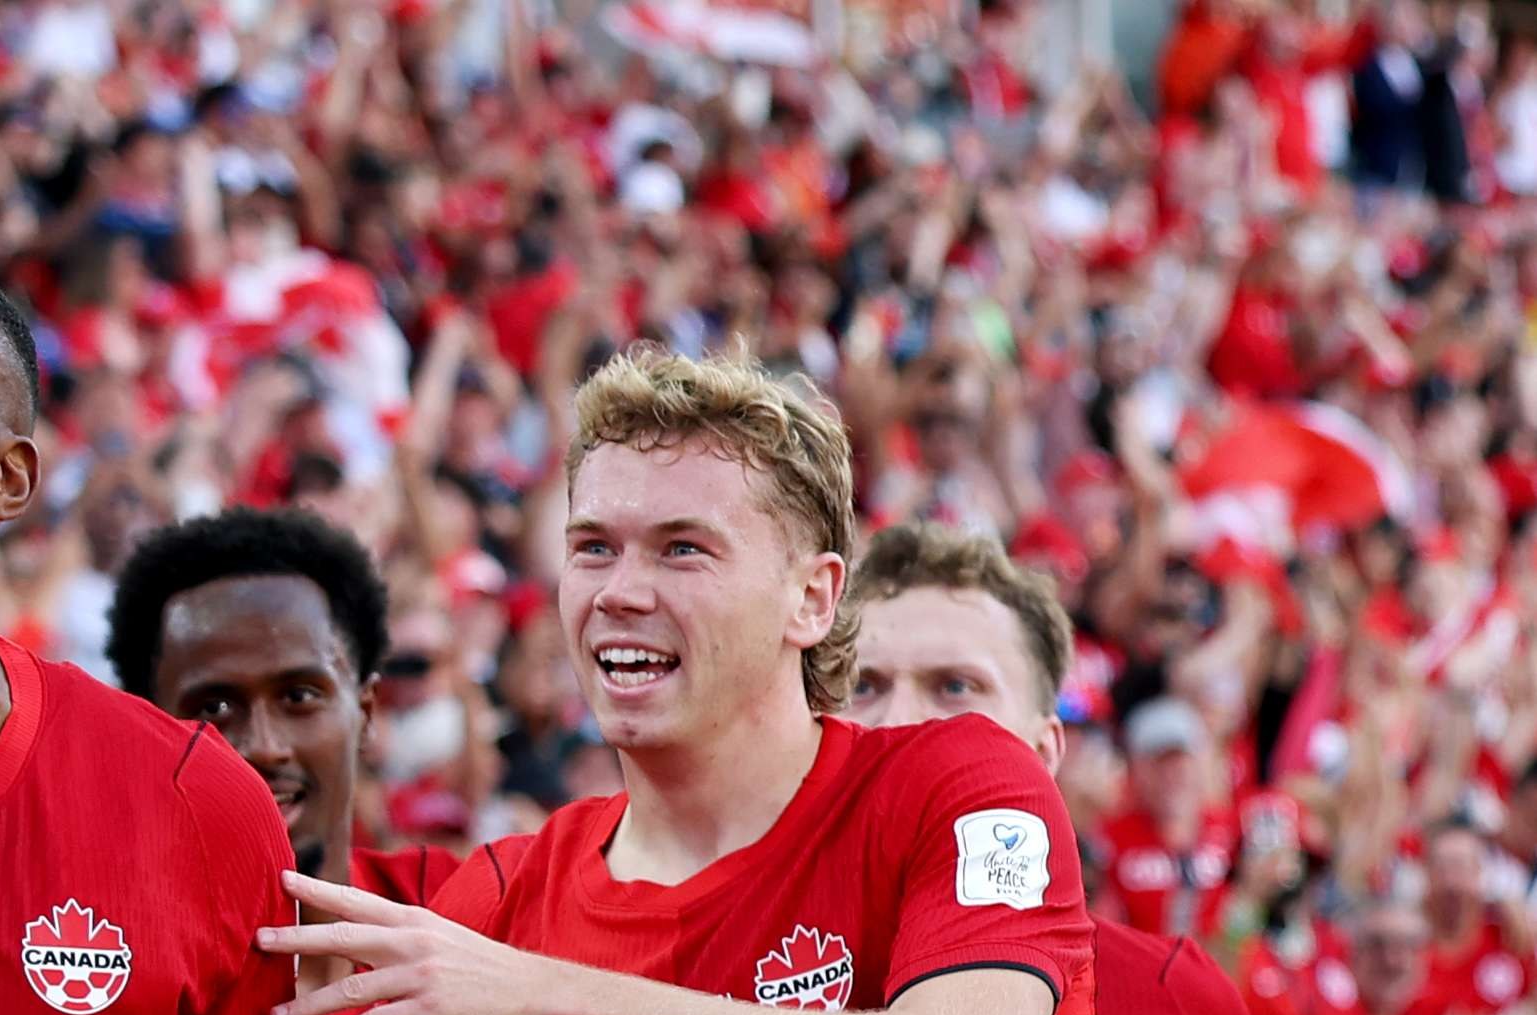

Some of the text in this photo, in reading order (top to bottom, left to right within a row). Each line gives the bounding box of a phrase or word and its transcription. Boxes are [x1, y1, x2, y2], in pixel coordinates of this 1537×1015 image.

[988, 868, 1026, 887] PEACE
[24, 949, 127, 970] CANADA
[757, 961, 851, 1000] CANADA
